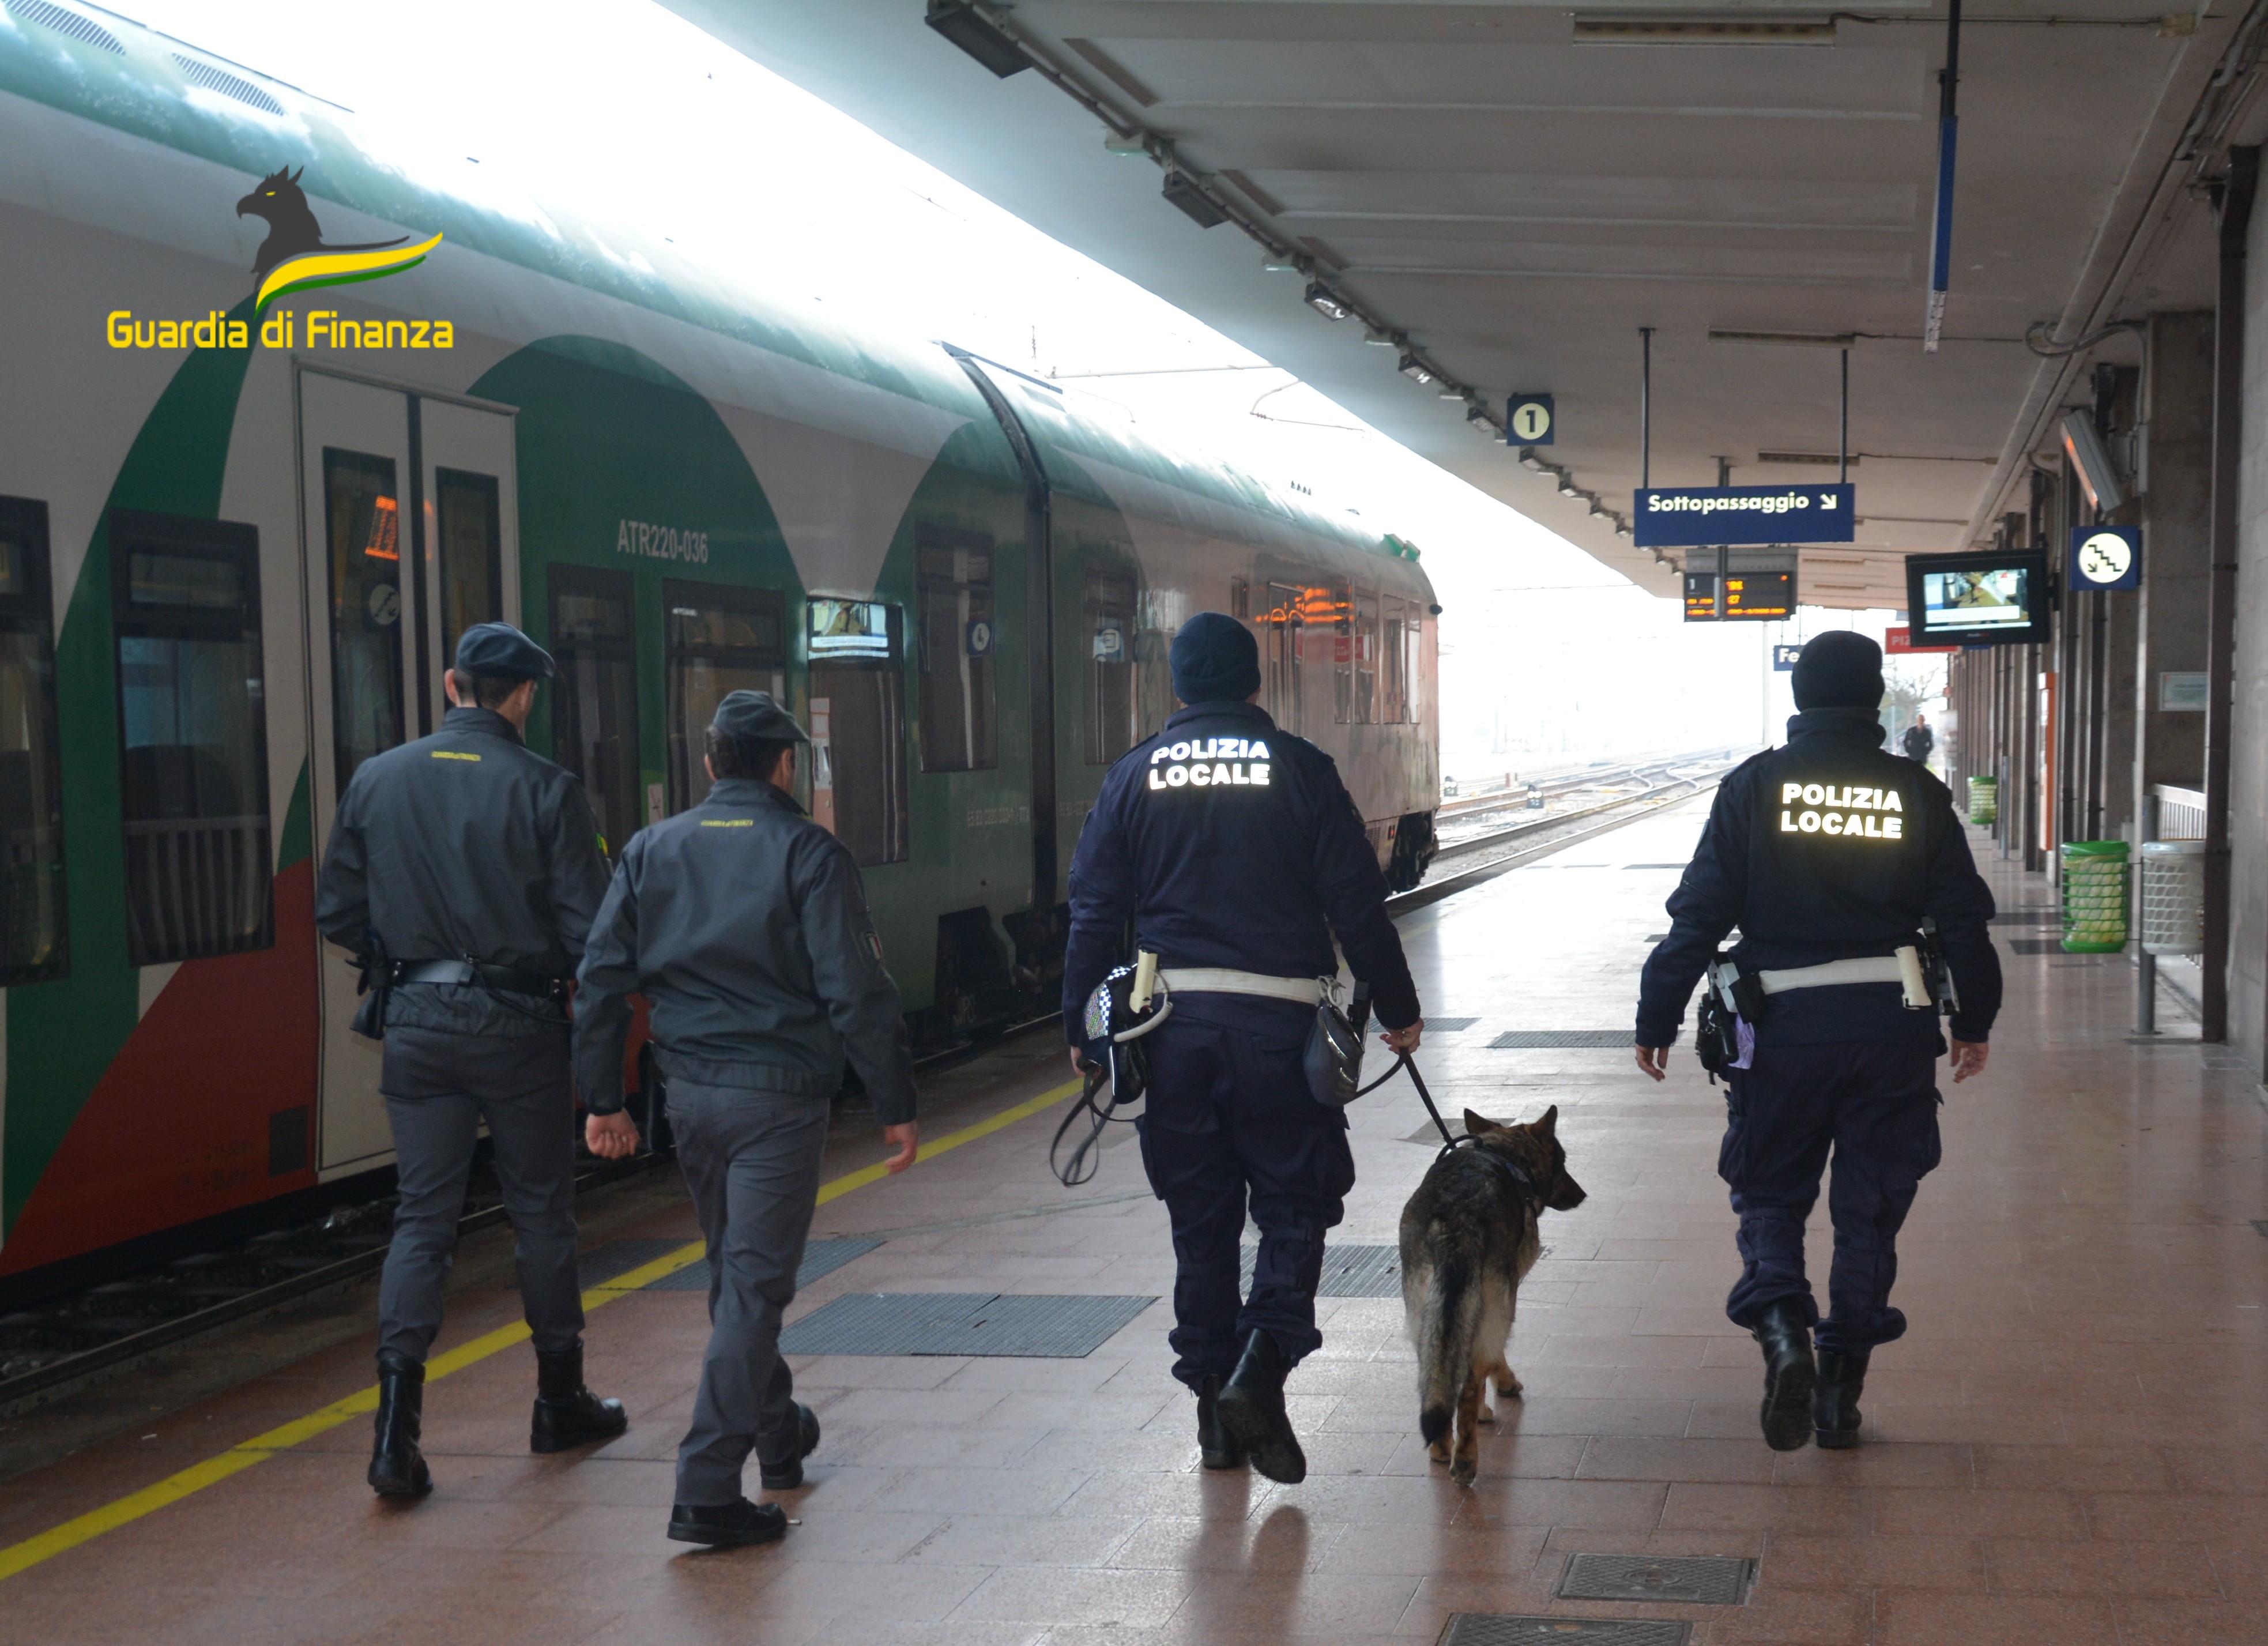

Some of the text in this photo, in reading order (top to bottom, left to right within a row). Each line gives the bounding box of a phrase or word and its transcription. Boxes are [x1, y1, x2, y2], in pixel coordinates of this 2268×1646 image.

[1525, 409, 1536, 433] 1
[1648, 491, 1810, 515] Sottopassaggio
[616, 518, 709, 564] ATR220-036
[1892, 635, 1911, 646] PIZ
[1779, 647, 1800, 663] Fe
[1151, 738, 1271, 764] POLIZIA
[1149, 763, 1271, 790] LOCALE
[1782, 782, 1903, 812] POLIZIA
[1780, 810, 1902, 839] LOCALE
